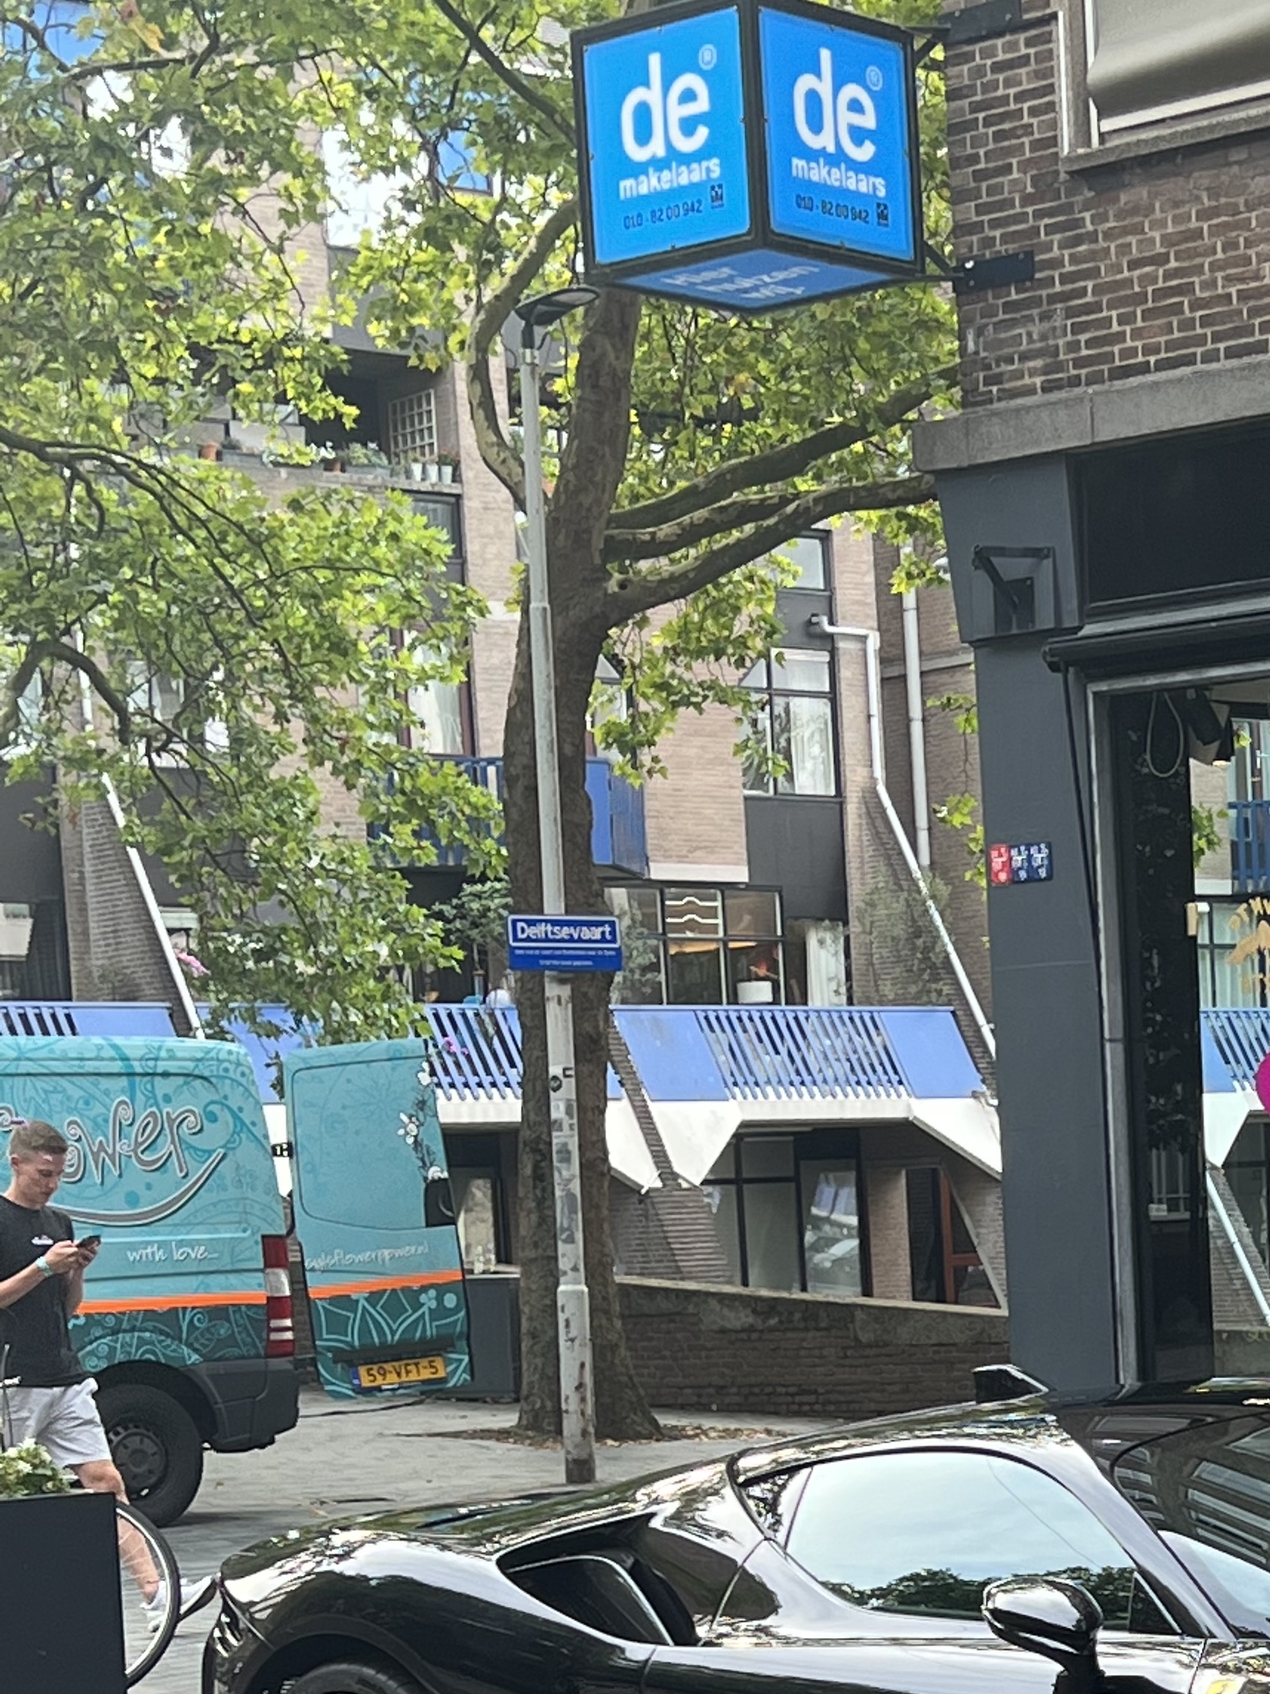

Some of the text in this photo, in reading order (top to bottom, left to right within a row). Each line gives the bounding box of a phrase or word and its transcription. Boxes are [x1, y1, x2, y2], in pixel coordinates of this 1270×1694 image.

[621, 51, 710, 162] de
[793, 46, 877, 162] de
[619, 157, 721, 200] makelaars
[791, 156, 886, 198] makelaars
[516, 921, 613, 940] Delftsevaart
[126, 1243, 168, 1262] with
[365, 1360, 439, 1383] 59-VFT-5
